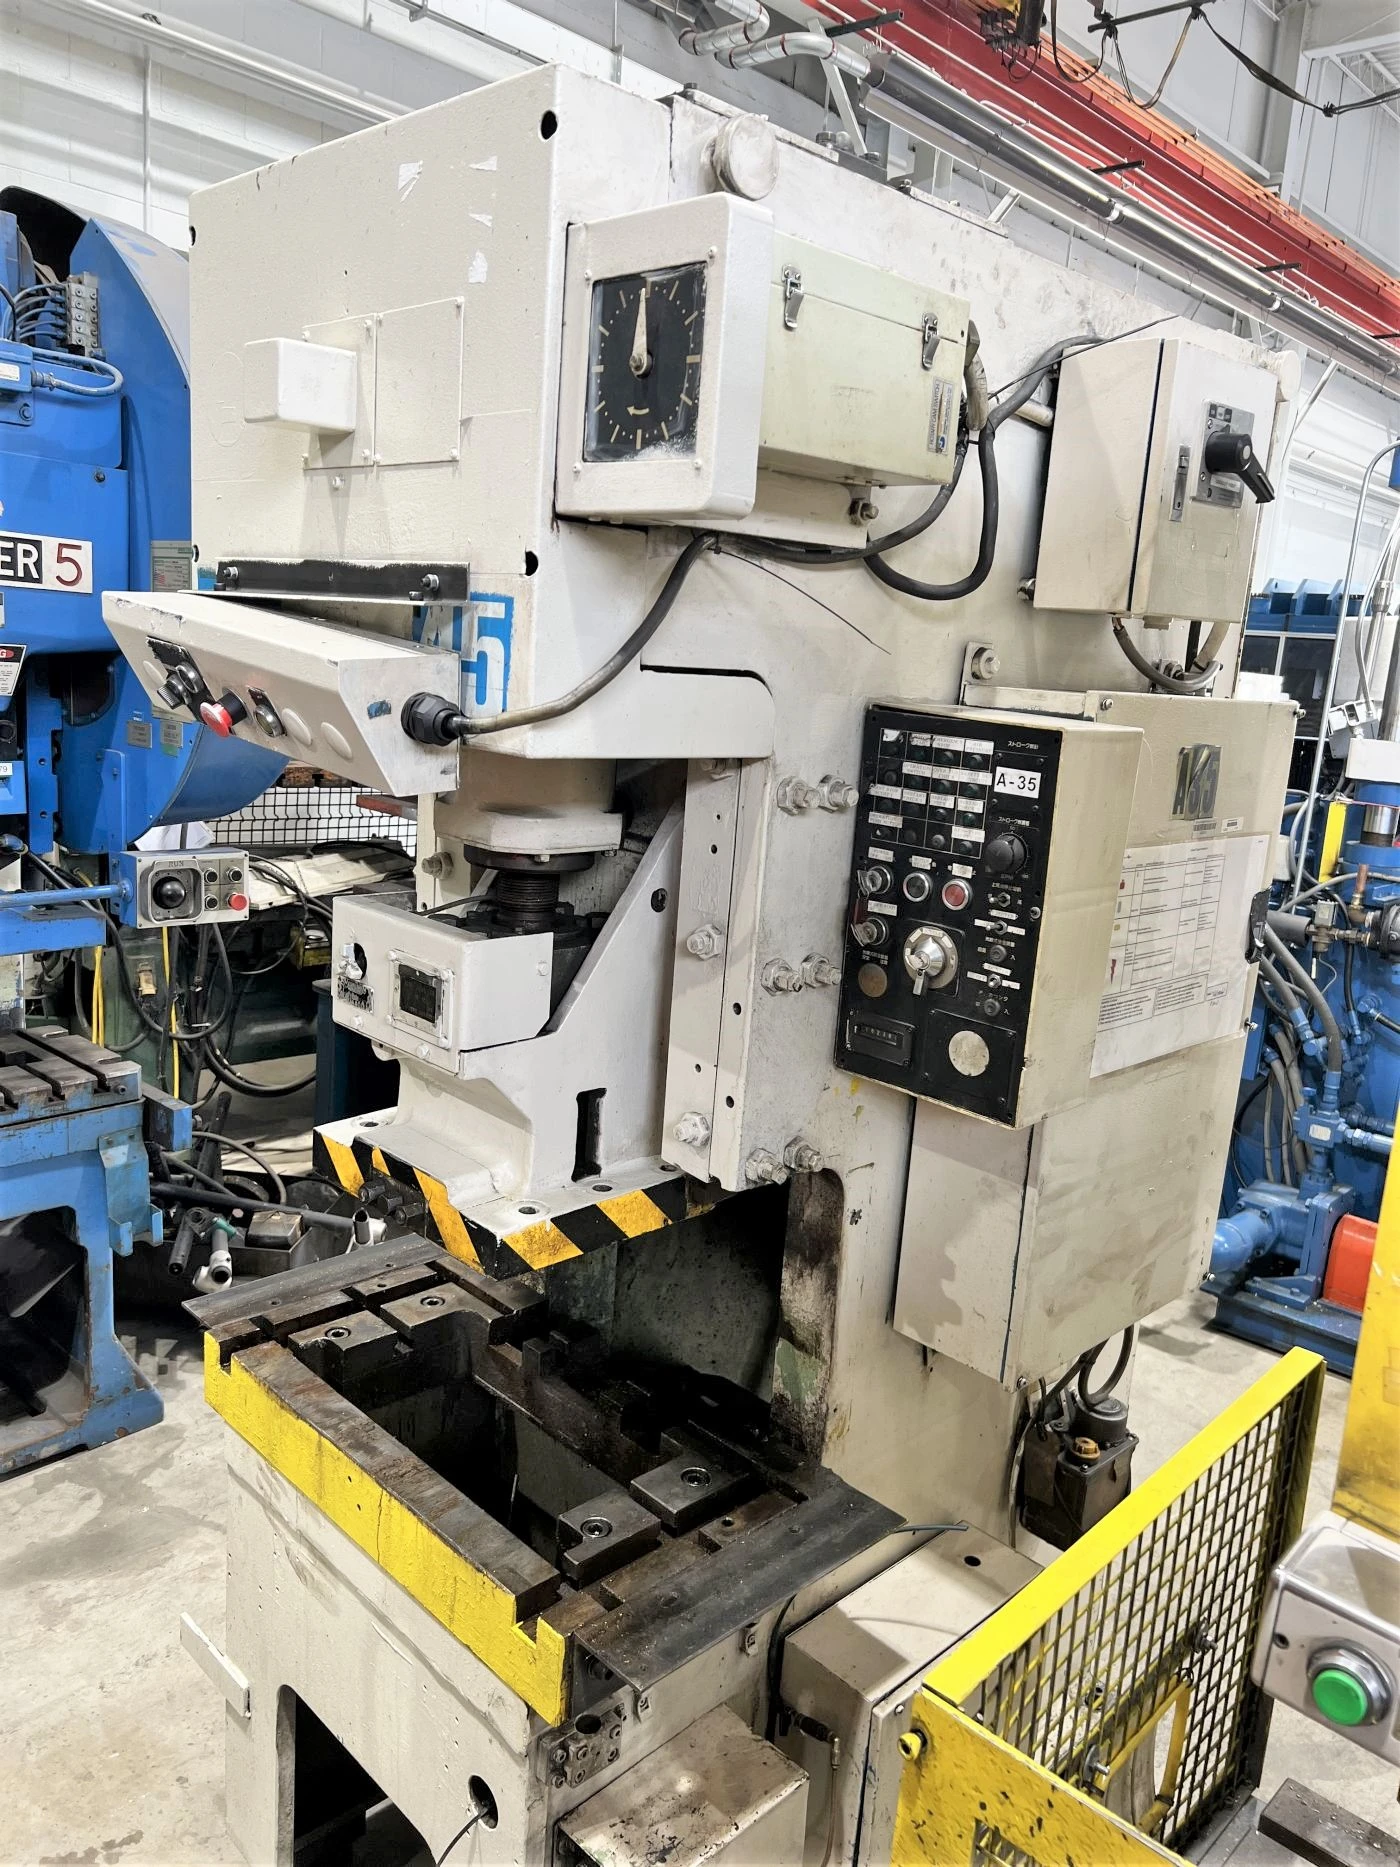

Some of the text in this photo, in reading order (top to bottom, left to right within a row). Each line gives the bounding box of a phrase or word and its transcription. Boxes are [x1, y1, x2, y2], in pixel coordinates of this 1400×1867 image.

[0, 540, 83, 586] ER 5
[996, 772, 1037, 792] A-35
[168, 860, 184, 868] RUN
